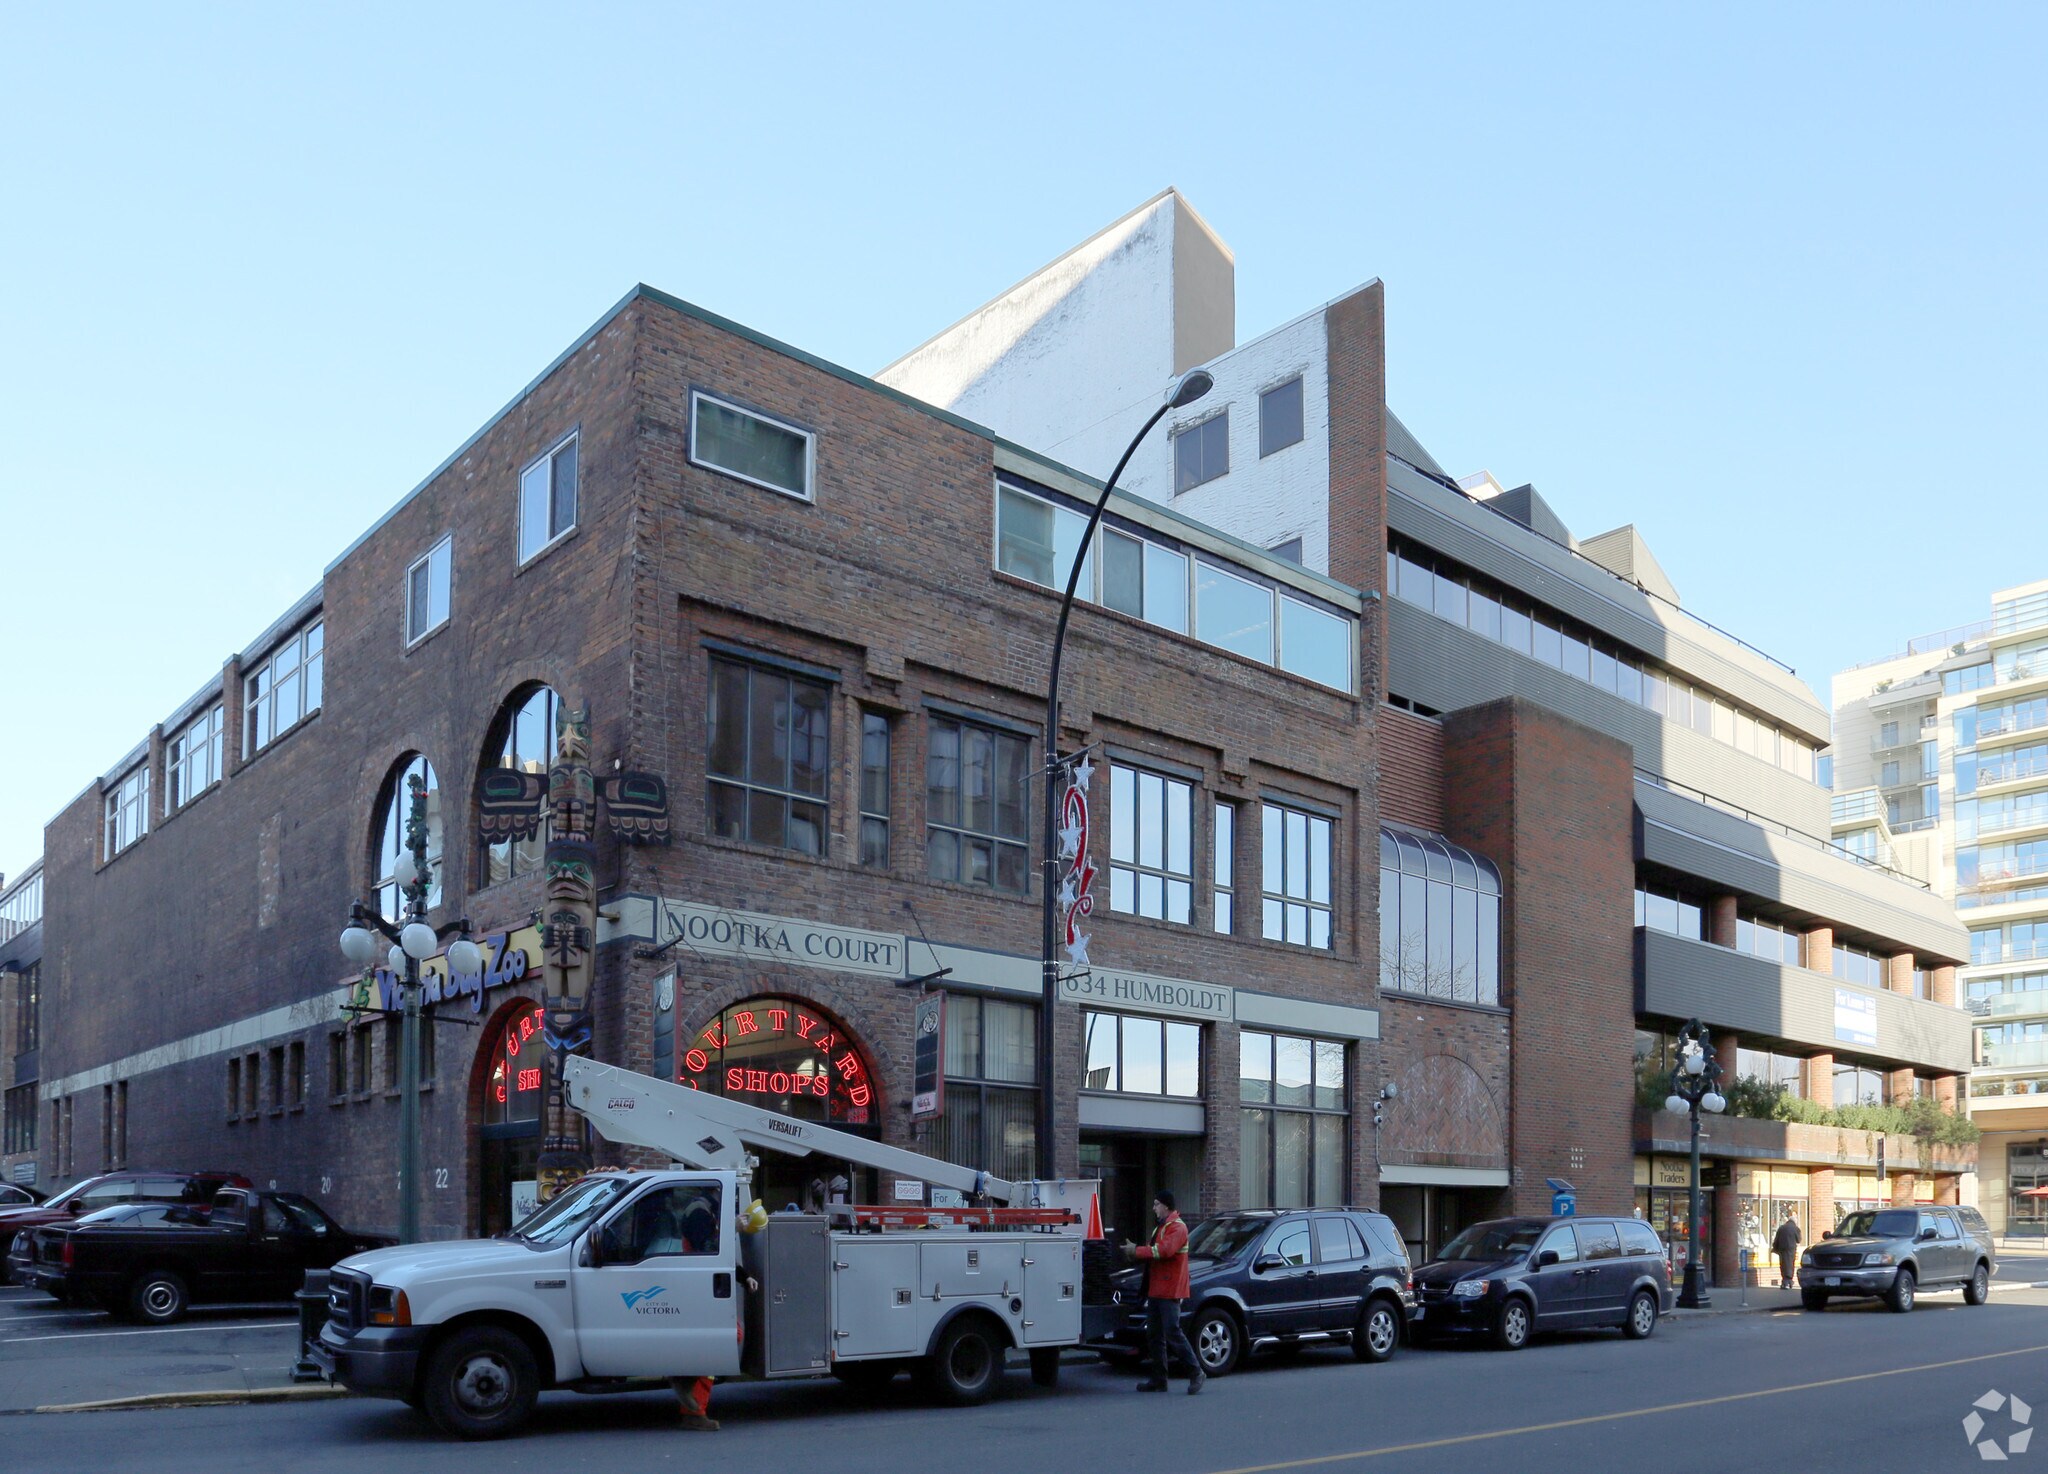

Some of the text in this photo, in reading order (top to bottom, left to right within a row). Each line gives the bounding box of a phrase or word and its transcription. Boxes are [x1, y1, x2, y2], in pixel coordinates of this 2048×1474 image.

[668, 911, 898, 966] NOOTKA COURT
[484, 932, 526, 988] Zoo
[1066, 971, 1227, 1012] 634 HUMBOLDT
[726, 1068, 829, 1097] SHOPS
[768, 1118, 802, 1138] VERSALIFT
[321, 1176, 331, 1194] 20
[435, 1168, 448, 1189] 22
[1660, 1172, 1685, 1184] Traders
[934, 1192, 948, 1203] For
[1560, 1202, 1569, 1215] P
[635, 1307, 680, 1315] VICTORIA
